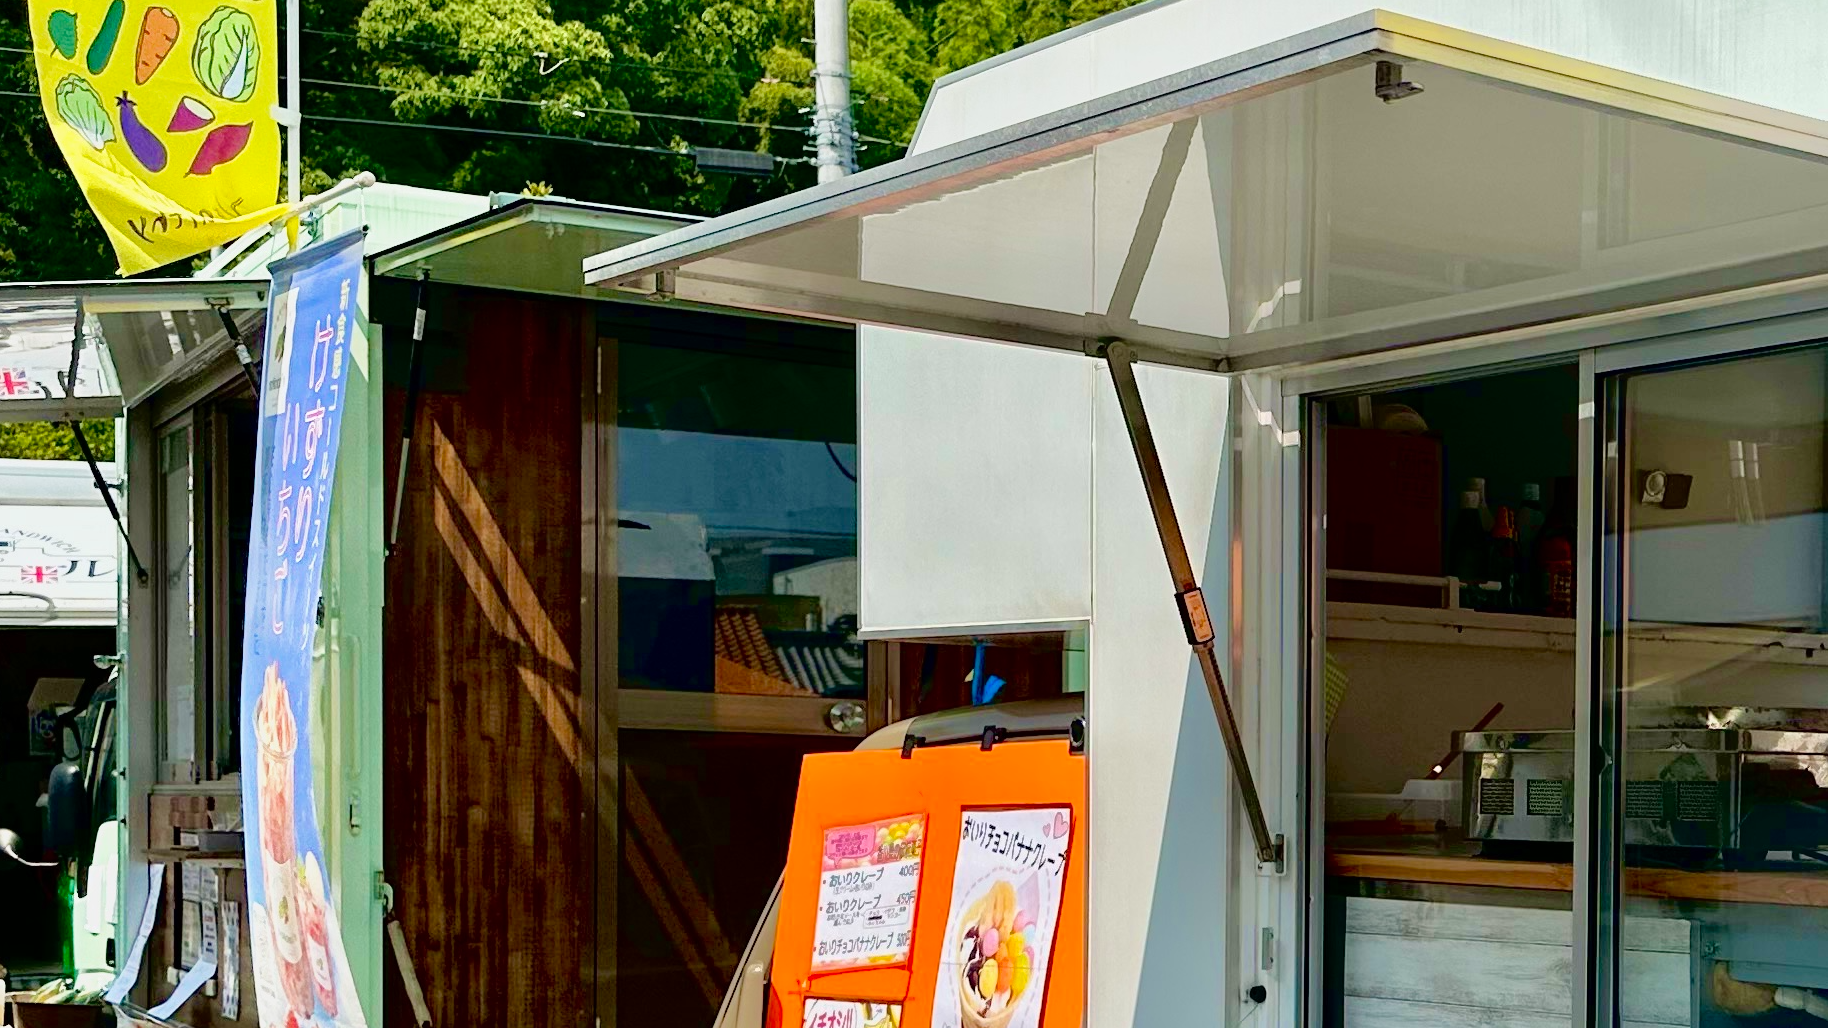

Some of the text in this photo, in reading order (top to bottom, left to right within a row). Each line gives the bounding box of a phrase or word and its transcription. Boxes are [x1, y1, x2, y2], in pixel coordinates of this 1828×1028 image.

[294, 314, 334, 564] けずり
[272, 402, 300, 636] いちご
[826, 894, 881, 914] おいりクレープ
[829, 867, 884, 887] おいりクレープ
